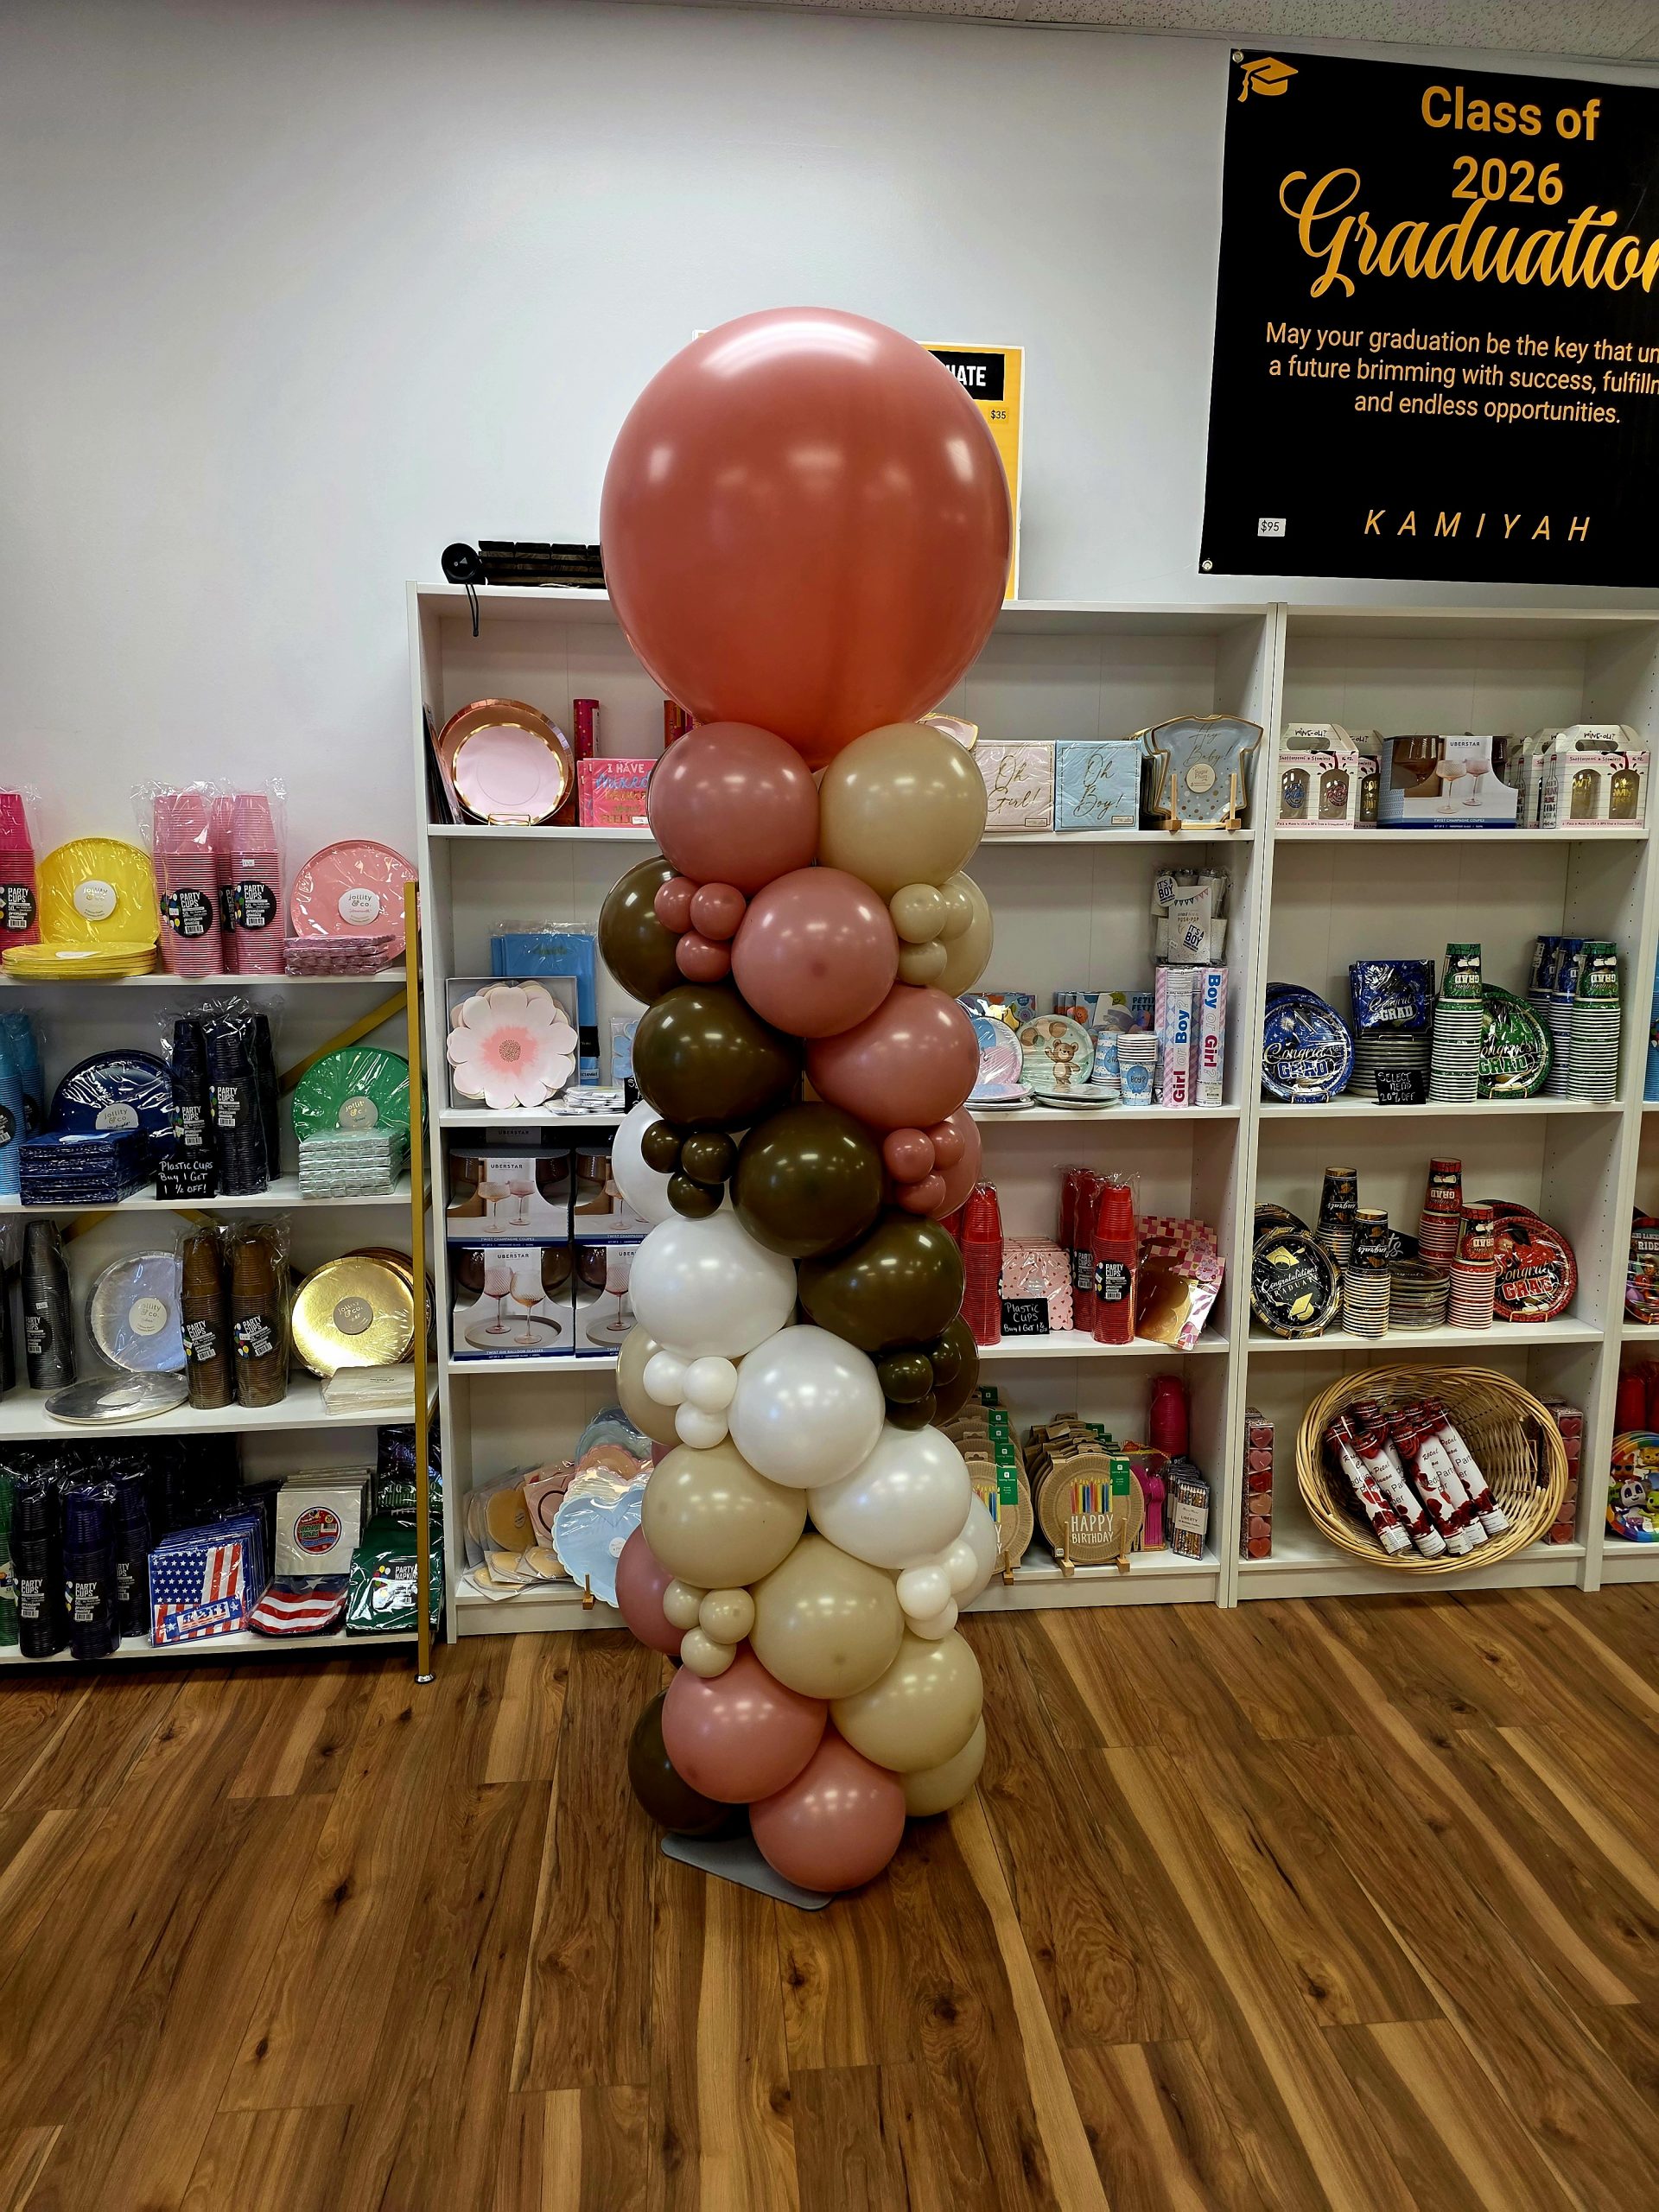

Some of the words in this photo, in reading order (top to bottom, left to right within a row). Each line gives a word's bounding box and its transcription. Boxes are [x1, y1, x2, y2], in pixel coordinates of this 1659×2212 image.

[1421, 86, 1542, 136] Class
[1555, 99, 1601, 141] of
[1452, 156, 1564, 205] 2026
[1266, 321, 1312, 350] May
[1316, 329, 1364, 351] your
[1369, 328, 1480, 353] graduation
[1486, 332, 1511, 355] be
[1516, 334, 1549, 357] the
[1554, 335, 1590, 365] key
[1593, 338, 1633, 362] that
[1268, 359, 1281, 376] a
[1287, 353, 1351, 379] future
[1357, 357, 1456, 389] brimming
[1462, 364, 1503, 386] with
[1509, 371, 1597, 395] success,
[1354, 391, 1394, 413] and
[1399, 392, 1478, 416] endless
[1484, 400, 1620, 424] opportunities.
[990, 409, 1007, 421] $35
[1260, 519, 1281, 533] $95
[1363, 509, 1591, 542] KAMIYAH
[616, 763, 645, 773] HAVE
[995, 754, 1030, 791] Oh
[1083, 753, 1116, 789] Oh
[987, 785, 1041, 814] Girl!
[1073, 785, 1124, 821] Boy!
[244, 884, 264, 893] PARTY
[1157, 879, 1168, 889] IT'S
[8, 887, 29, 897] PARTY
[180, 892, 200, 901] PARTY
[245, 891, 263, 900] CUPS
[1158, 884, 1173, 899] BOY
[8, 893, 27, 904] CUPS
[181, 899, 200, 909] CUPS
[1188, 924, 1201, 936] IT'S
[1185, 931, 1203, 947] BOY
[1454, 974, 1479, 984] GRAD
[1590, 973, 1617, 983] GRAD
[1204, 974, 1221, 1009] Boy
[1381, 1005, 1414, 1021] GRAD
[1205, 1013, 1217, 1032] or
[1480, 1043, 1535, 1057] ongrats
[1176, 1047, 1187, 1067] or
[1277, 1059, 1329, 1080] GRAD
[1478, 1056, 1529, 1076] GRAD
[1377, 1071, 1413, 1083] SELECT
[218, 1086, 238, 1096] PARTY
[1173, 1070, 1186, 1103] Girl
[218, 1093, 235, 1102] CUPS
[1379, 1092, 1400, 1103] 20%
[1402, 1092, 1415, 1101] OFF
[104, 1108, 128, 1118] jollity
[181, 1105, 201, 1115] PARTY
[182, 1112, 200, 1121] CUPS
[158, 1172, 179, 1183] Buy
[187, 1183, 207, 1193] OFF!
[1430, 1188, 1455, 1199] GRAD
[1262, 1264, 1319, 1294] Congratulations
[186, 1319, 207, 1332] PARTY
[243, 1315, 262, 1330] PARTY
[245, 1322, 263, 1335] CUPS
[188, 1327, 207, 1338] CUPS
[1071, 1514, 1114, 1533] HAPPY
[1071, 1531, 1114, 1544] BIRTHDAY
[22, 1579, 43, 1588] PARTY
[75, 1581, 98, 1591] PARTY
[75, 1589, 93, 1598] CUPS
